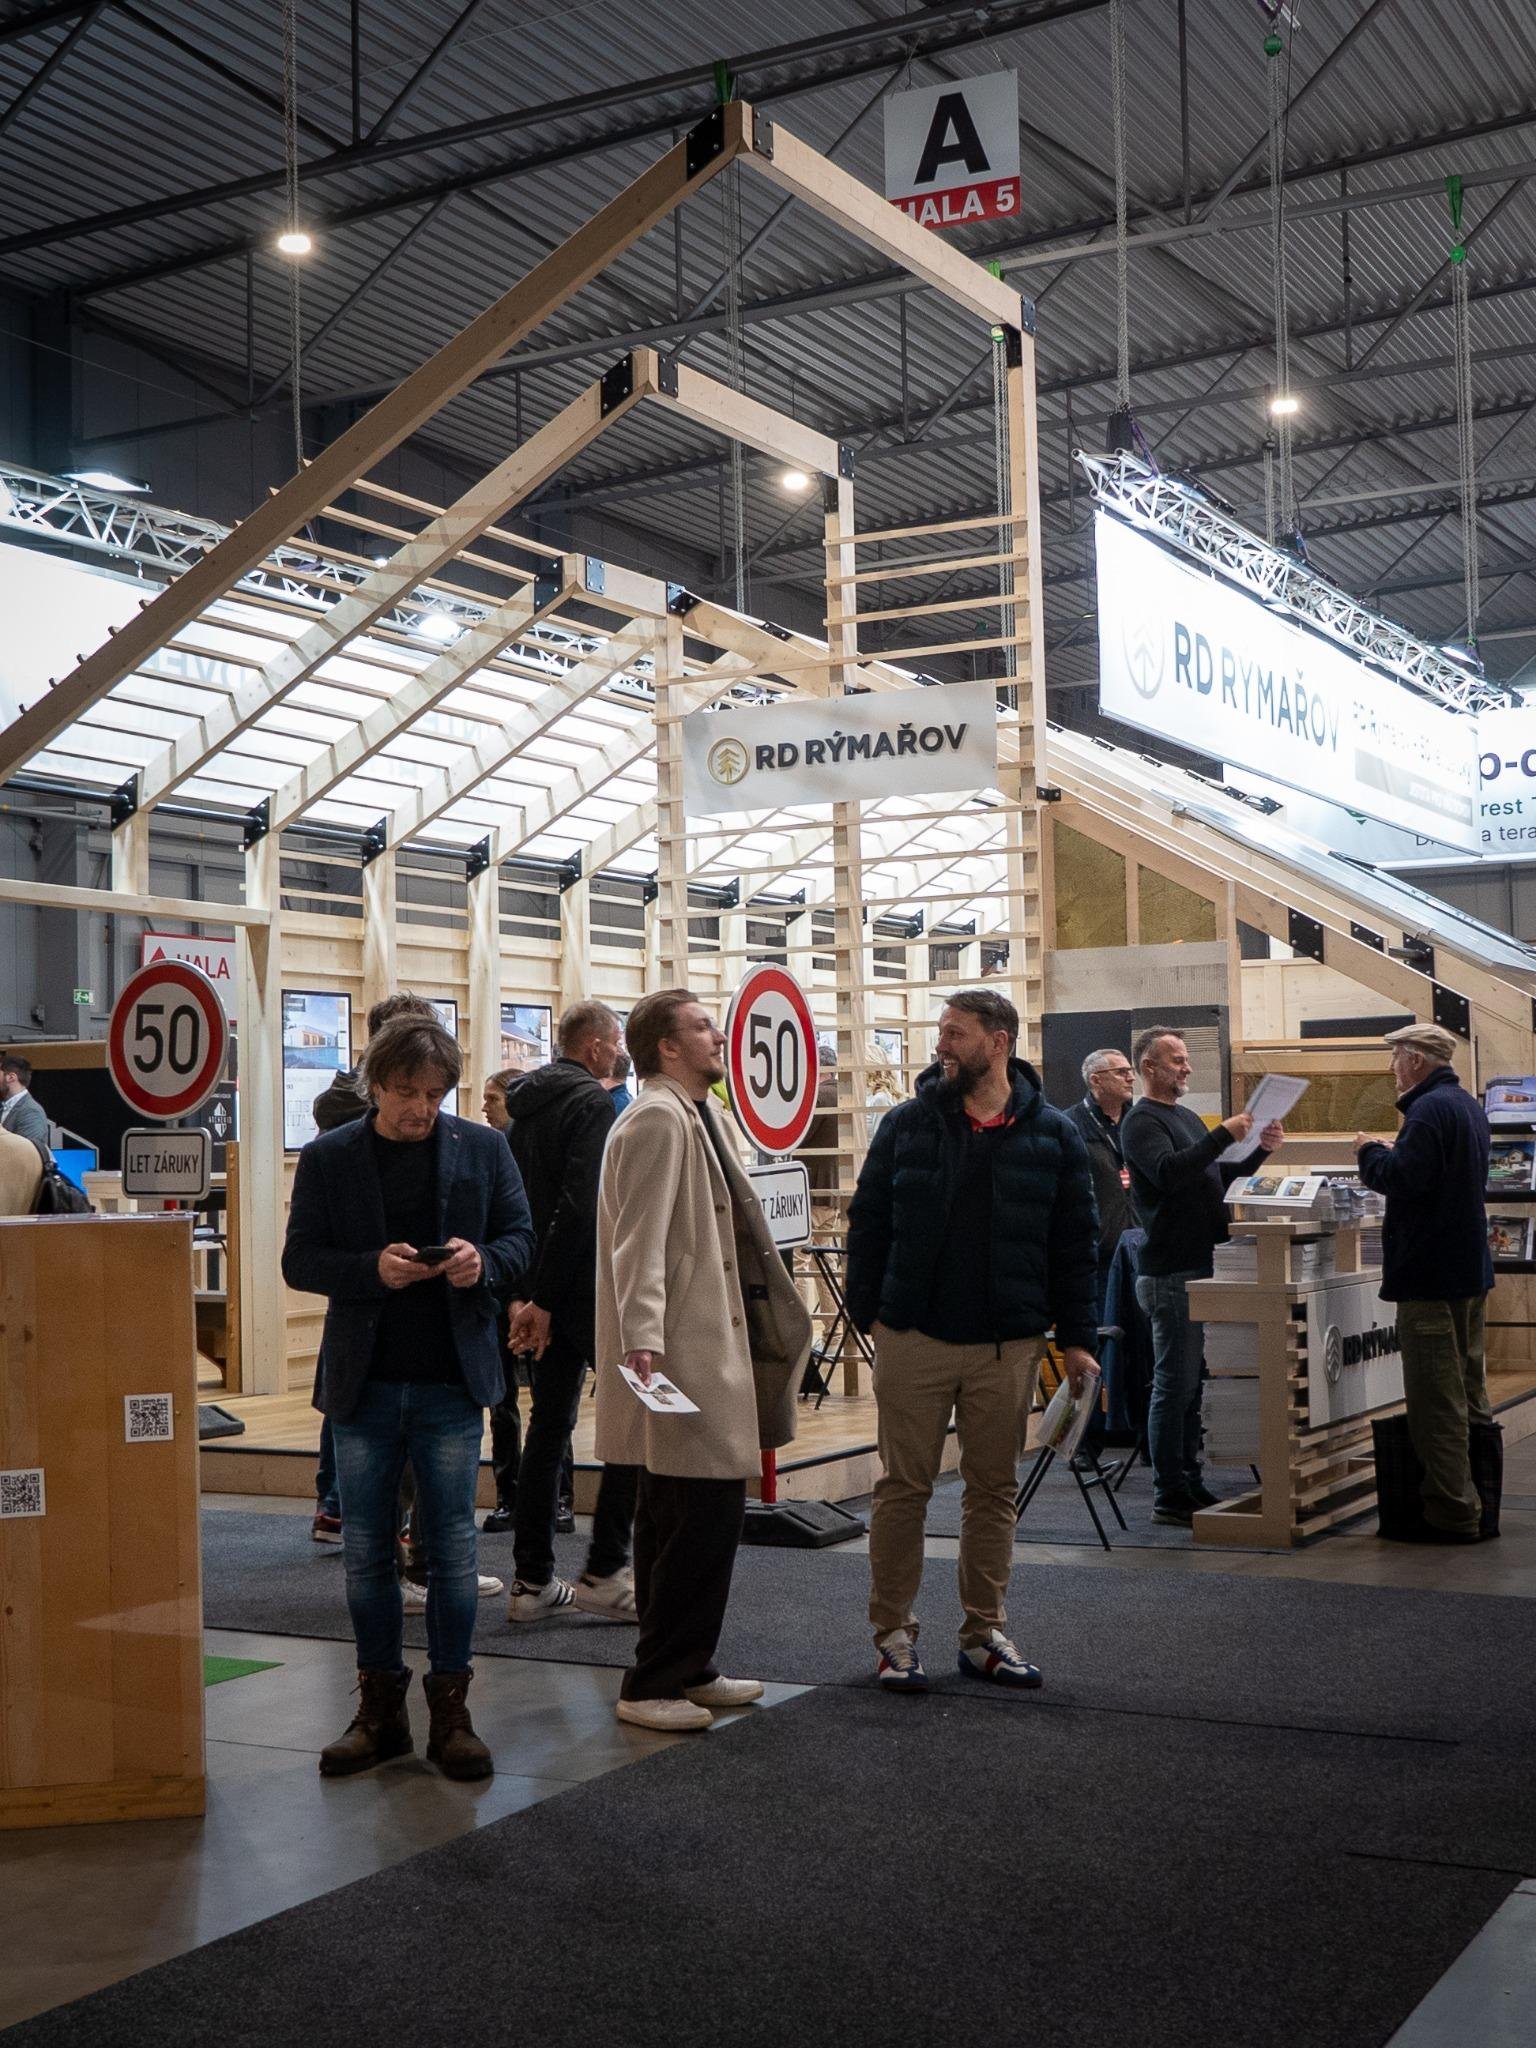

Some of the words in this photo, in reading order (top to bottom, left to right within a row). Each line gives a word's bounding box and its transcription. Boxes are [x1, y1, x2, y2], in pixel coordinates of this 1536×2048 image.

[914, 92, 991, 185] A
[996, 184, 1015, 212] 5
[1175, 621, 1213, 696] RD
[756, 743, 798, 770] RD
[805, 722, 967, 765] RÝMAŘOV
[133, 1004, 200, 1075] 50
[750, 1013, 798, 1102] 50
[130, 1154, 152, 1174] LET
[154, 1151, 199, 1174] ZÁRUKY
[770, 1191, 803, 1219] ZÁRUKY
